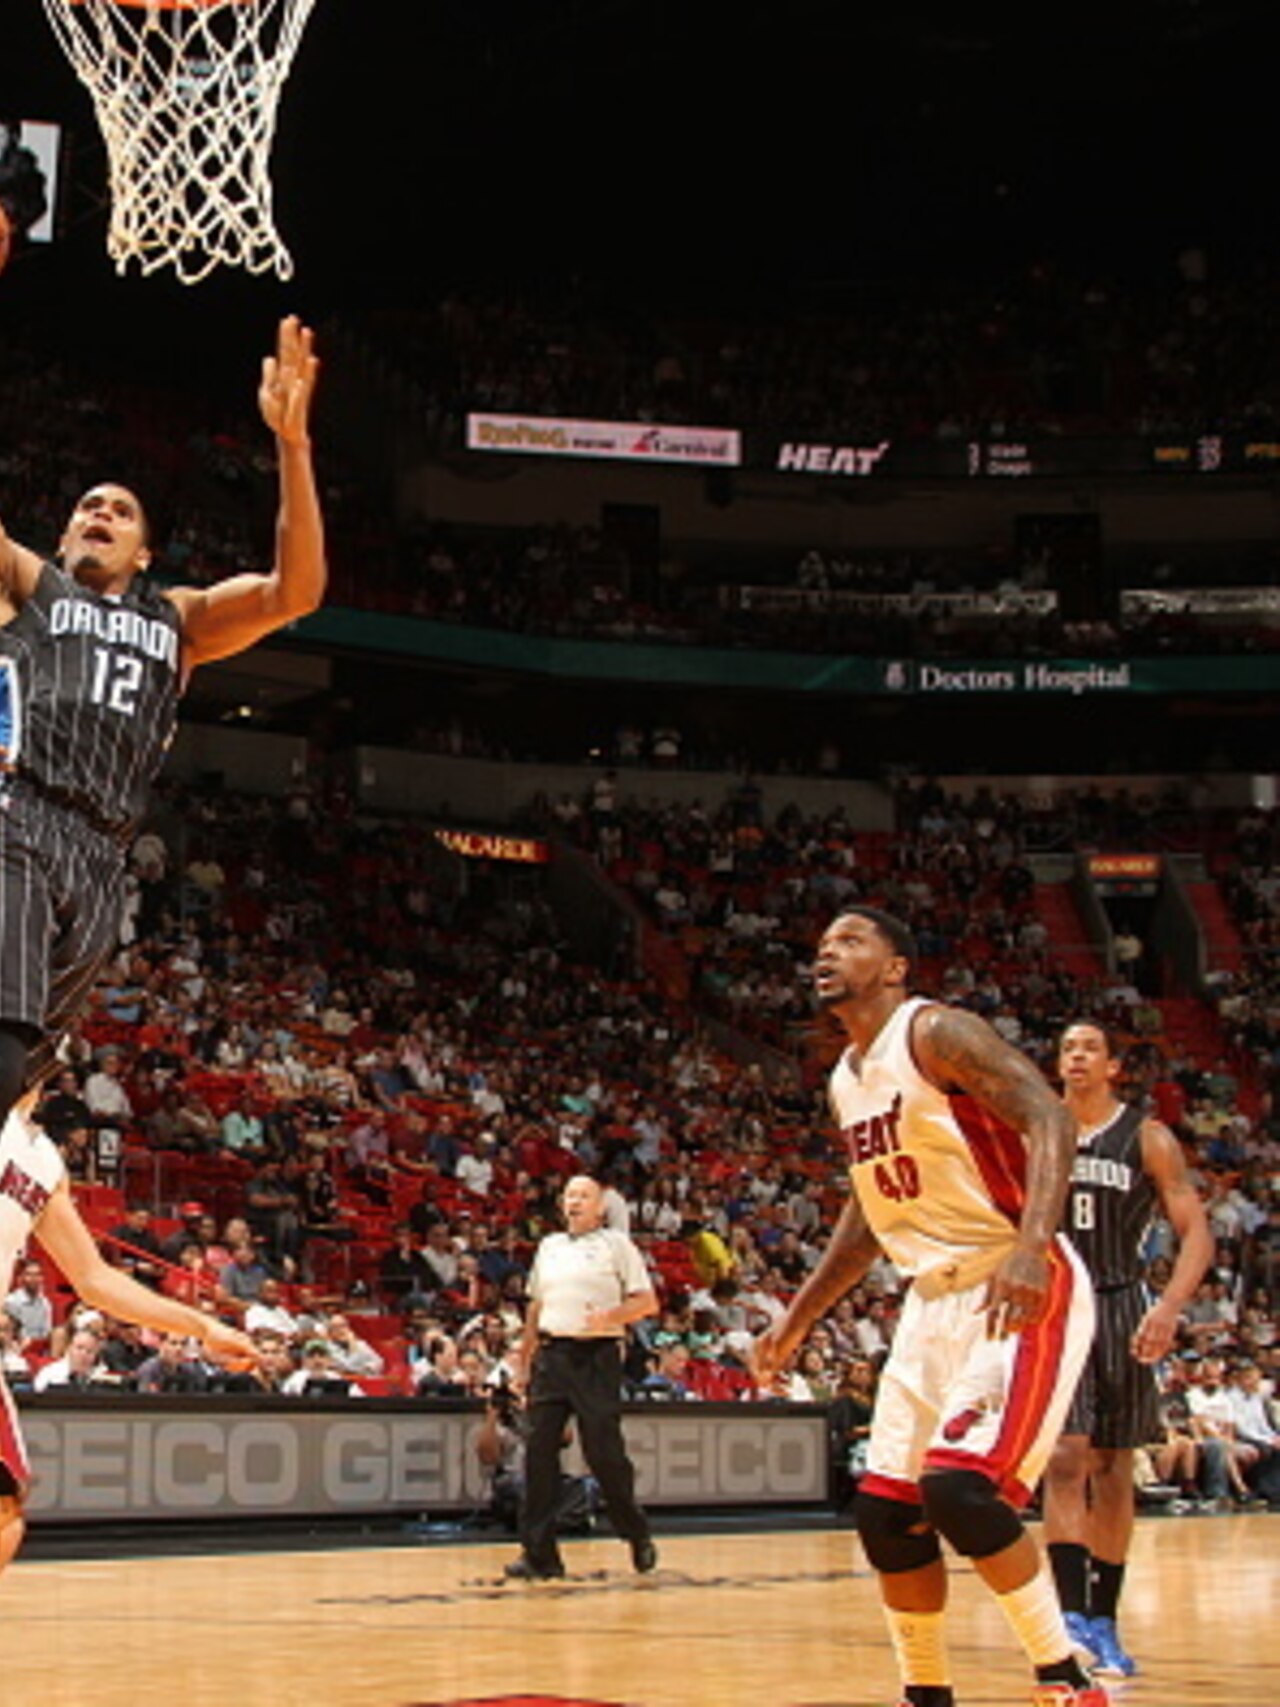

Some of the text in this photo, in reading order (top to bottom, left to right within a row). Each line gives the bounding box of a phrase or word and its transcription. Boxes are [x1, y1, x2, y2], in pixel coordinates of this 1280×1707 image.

[778, 441, 889, 475] HEAT
[93, 649, 143, 716] 12
[921, 663, 1130, 695] Doctors Hospital
[874, 1155, 921, 1203] 40
[1073, 1193, 1096, 1230] 8
